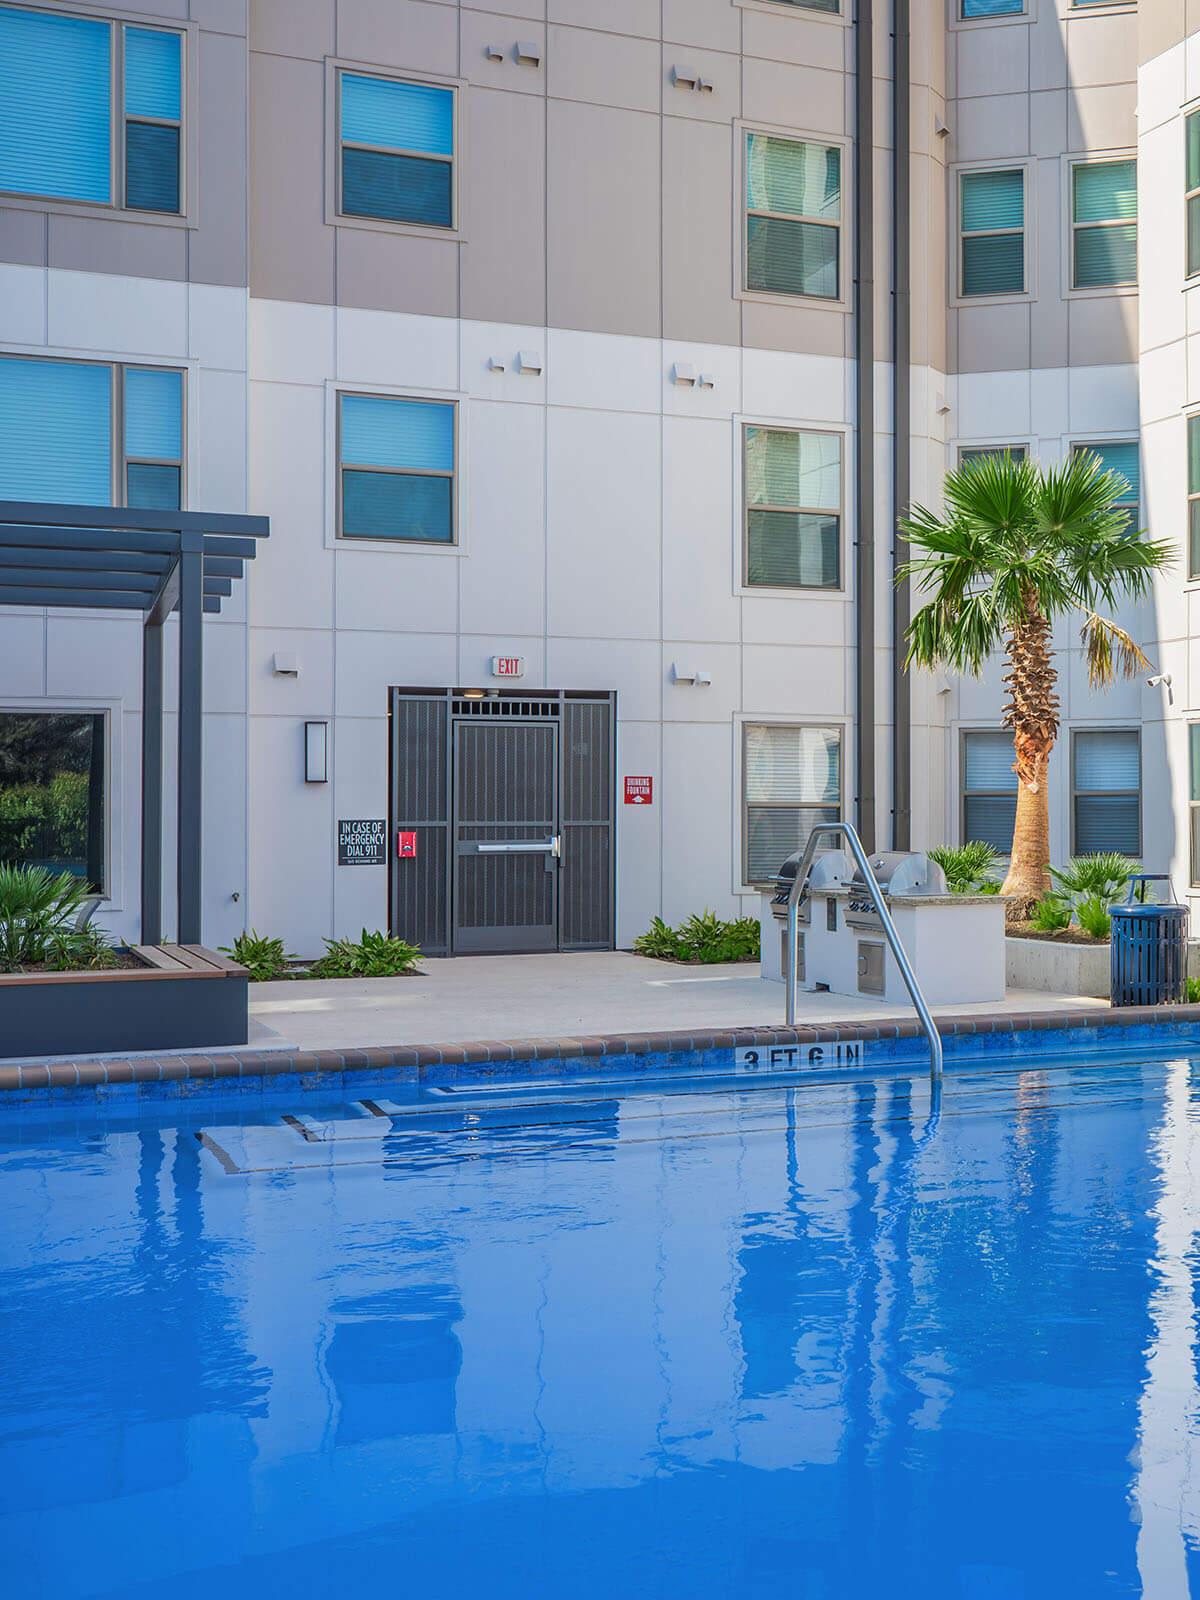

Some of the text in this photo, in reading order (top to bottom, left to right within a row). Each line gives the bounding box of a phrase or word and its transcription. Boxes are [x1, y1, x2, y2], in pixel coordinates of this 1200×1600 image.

[498, 658, 520, 674] EXIT
[342, 822, 383, 833] IN CASE OF
[340, 833, 385, 845] EMERGENCY
[347, 845, 377, 856] DIAL 911
